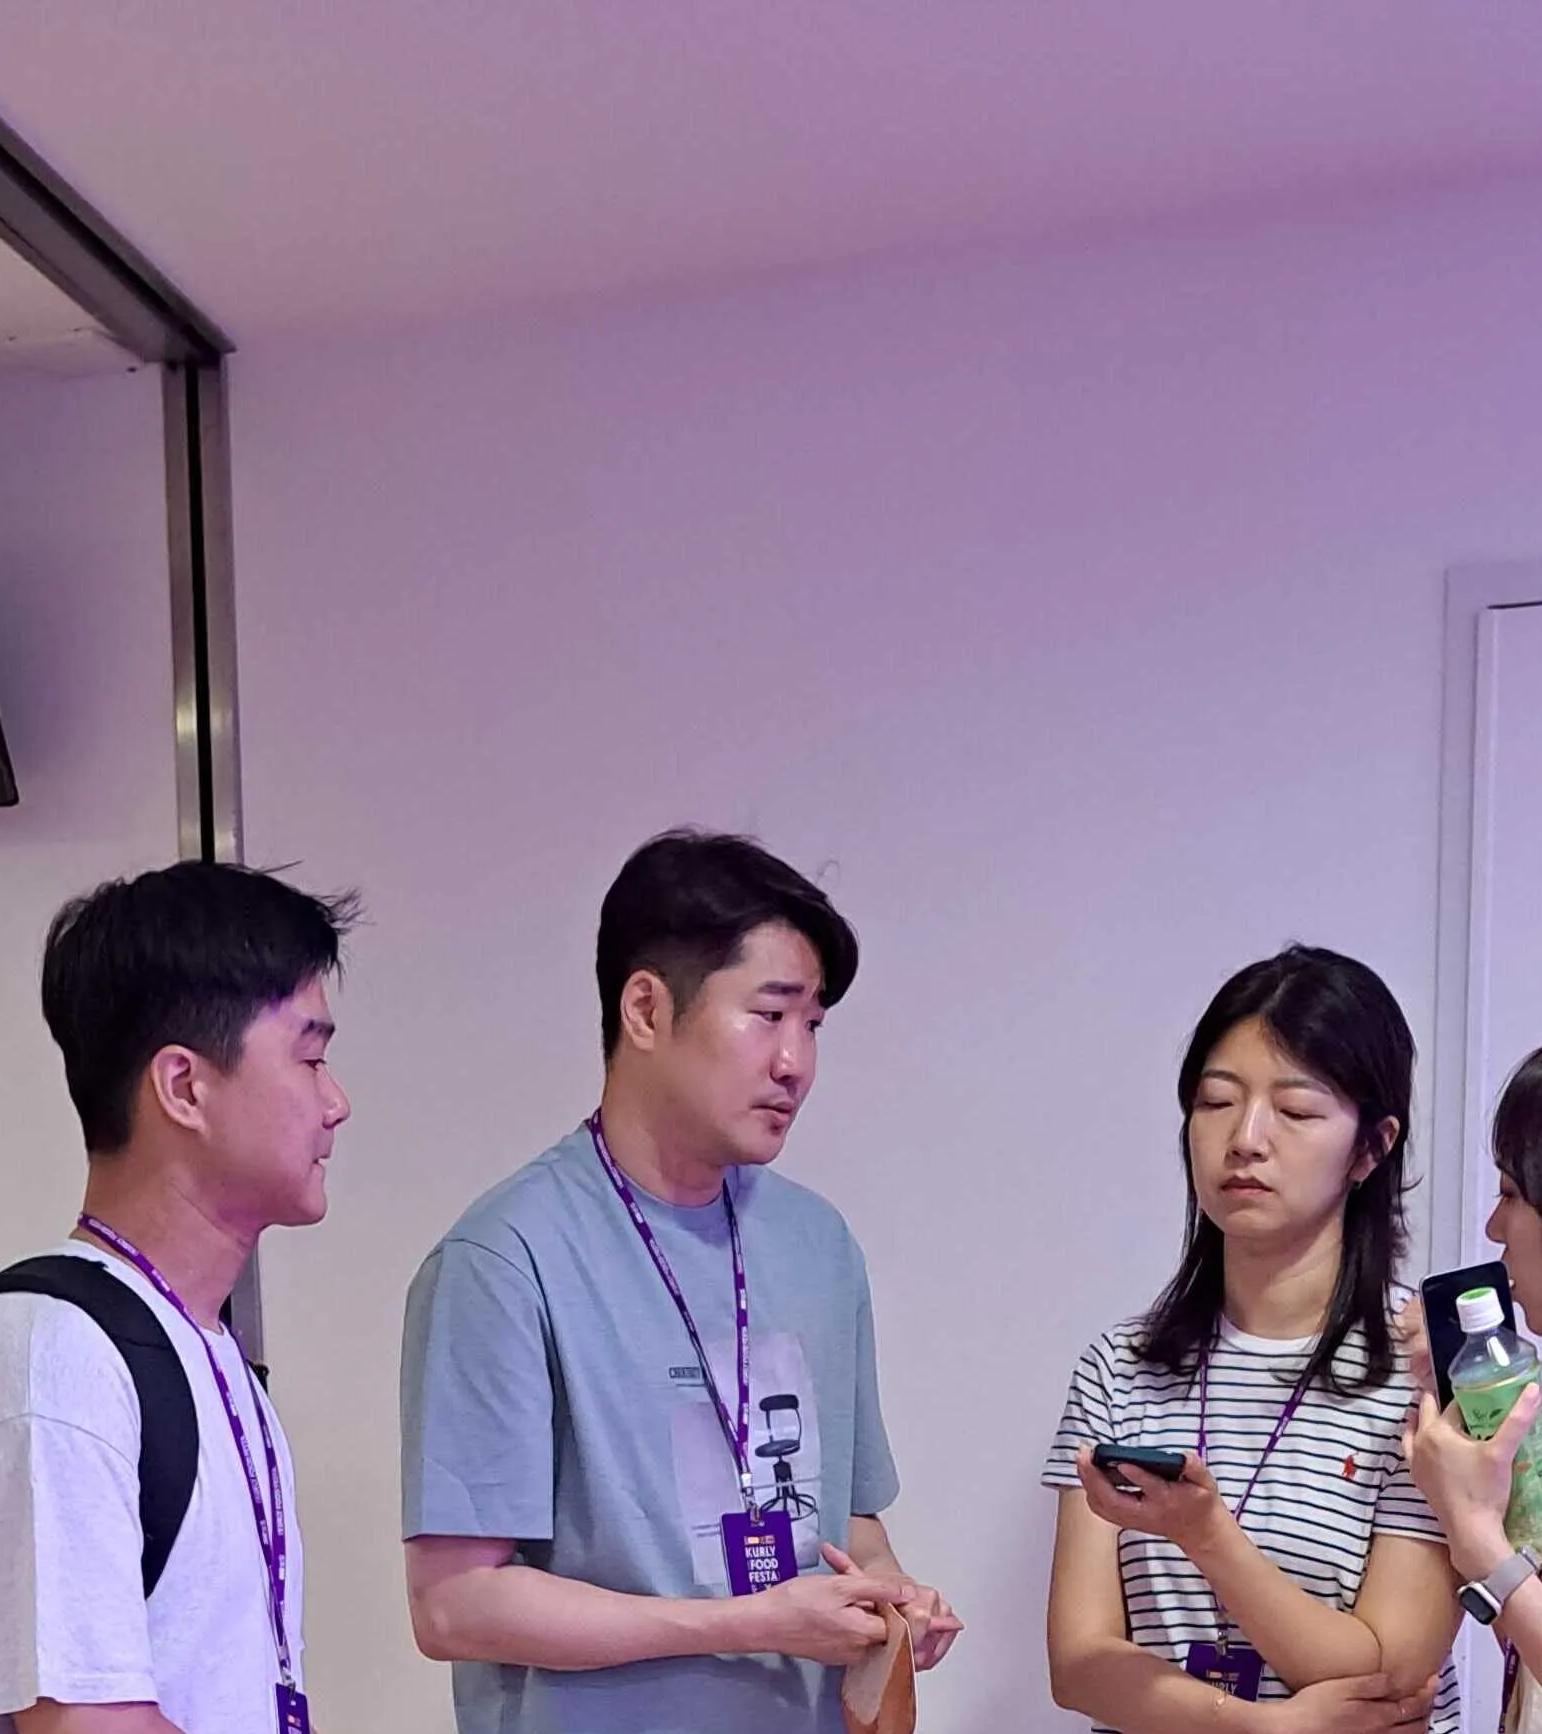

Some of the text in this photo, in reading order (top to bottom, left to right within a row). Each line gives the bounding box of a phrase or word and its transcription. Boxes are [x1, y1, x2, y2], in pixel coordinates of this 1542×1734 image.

[745, 1545, 776, 1558] KURLY
[749, 1558, 779, 1570] FOOD
[749, 1570, 779, 1583] FESTA
